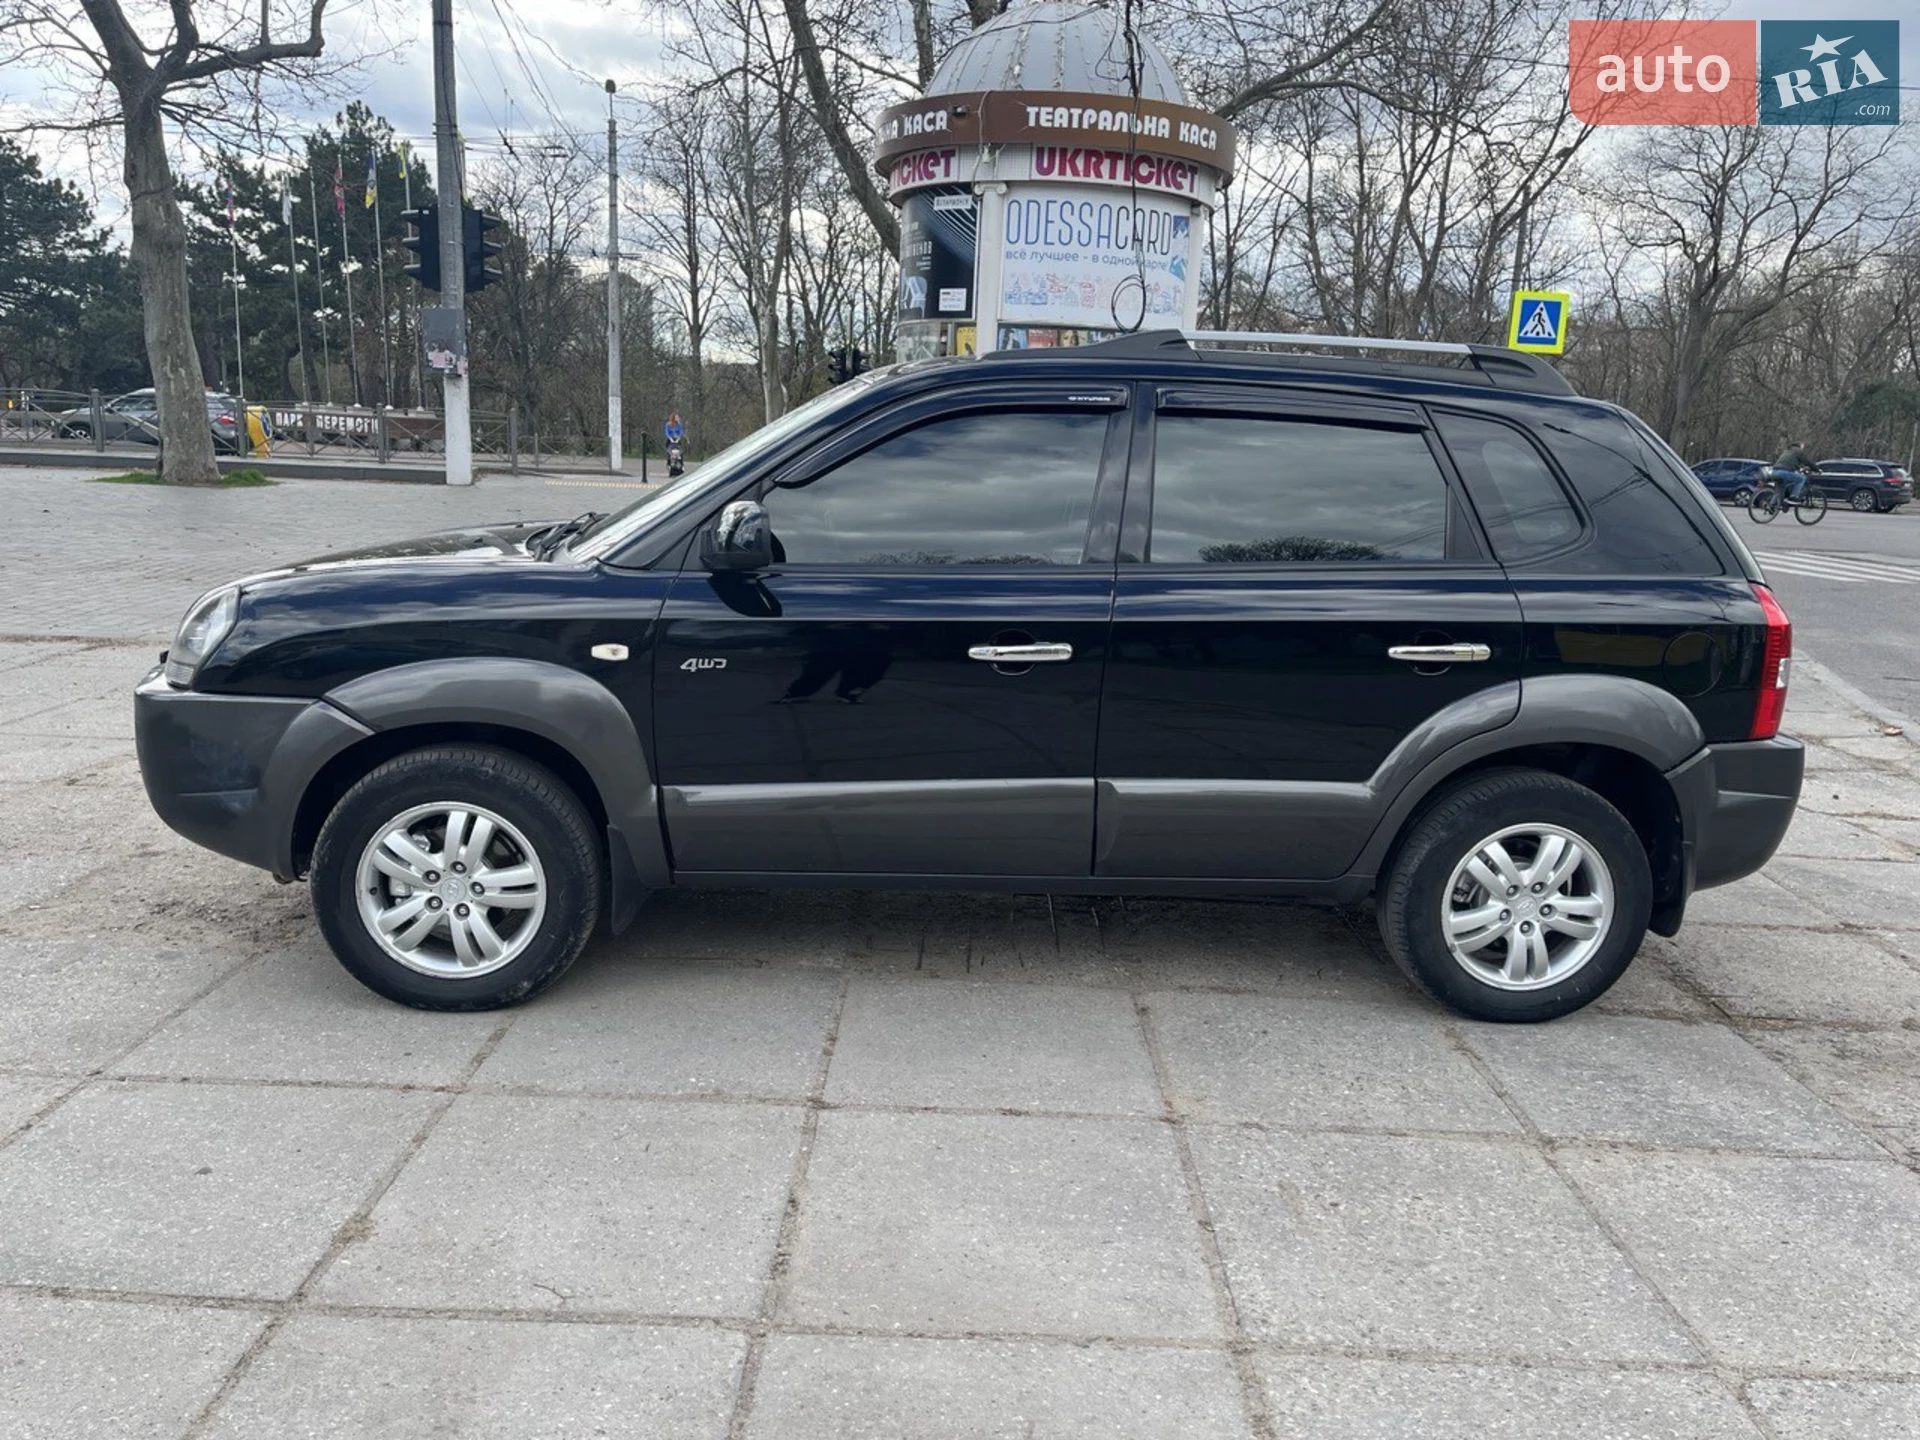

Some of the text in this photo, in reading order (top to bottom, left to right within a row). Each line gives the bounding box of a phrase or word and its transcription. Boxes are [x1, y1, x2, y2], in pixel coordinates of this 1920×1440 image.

[903, 110, 948, 136] КАСА
[1026, 106, 1217, 151] ТЕАТРАЛЬНА КАСА
[1029, 251, 1079, 263] лучшее
[275, 412, 304, 427] ПАРК
[680, 658, 727, 672] 4WD
